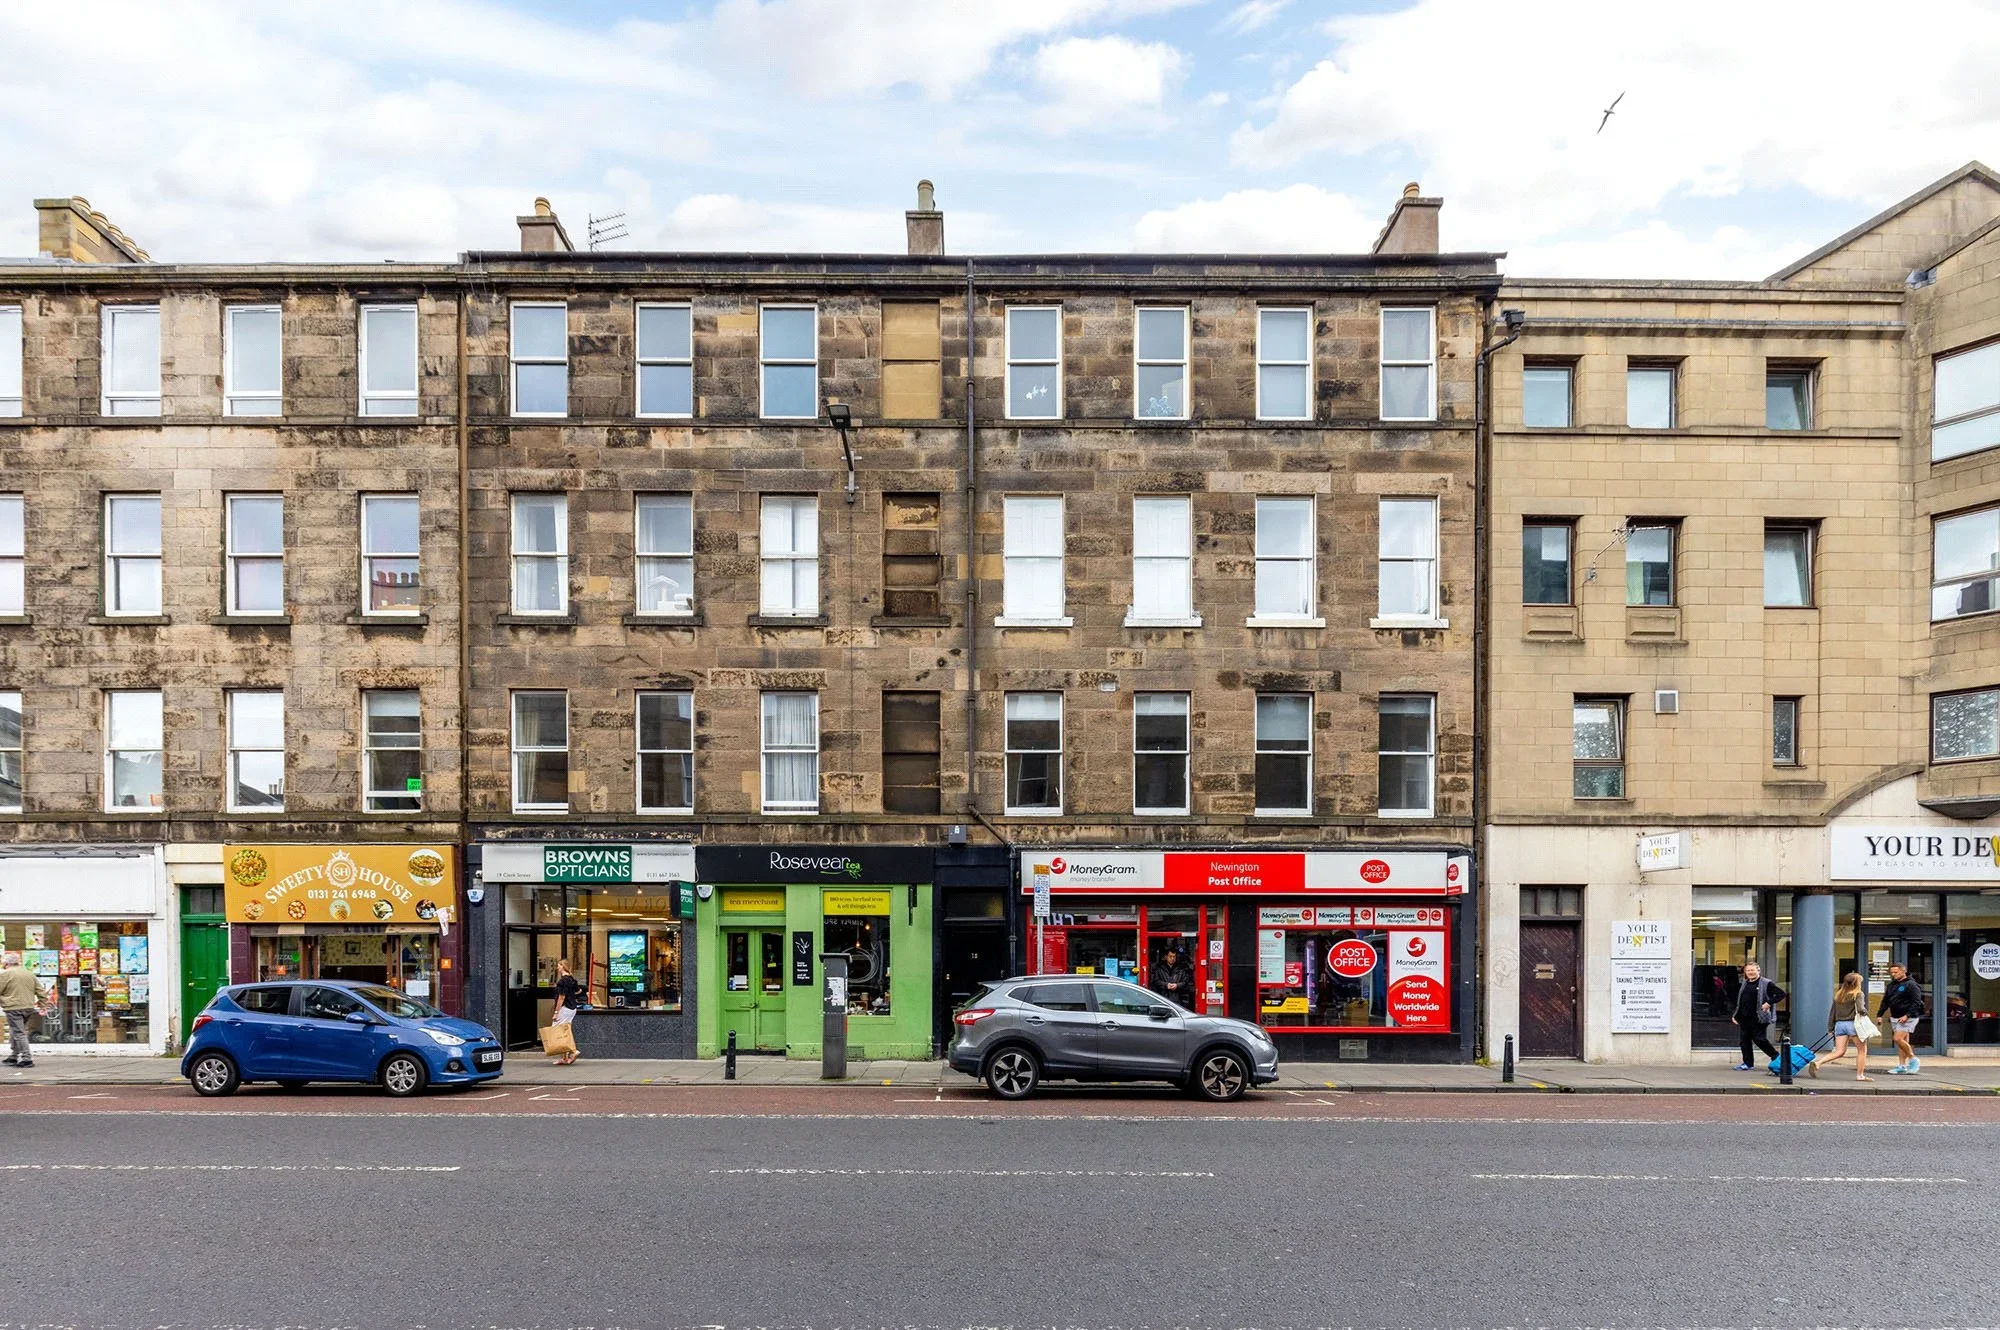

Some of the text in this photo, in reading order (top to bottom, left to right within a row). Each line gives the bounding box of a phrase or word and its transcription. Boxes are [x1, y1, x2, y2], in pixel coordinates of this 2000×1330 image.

[1649, 837, 1670, 846] YOUR
[1864, 836, 1943, 857] YOUR
[545, 850, 630, 864] BROWNS
[770, 851, 850, 870] Rosevear
[545, 864, 630, 878] OPTICIANS
[845, 861, 861, 871] tea
[1069, 864, 1136, 877] MoneyGram
[1210, 861, 1260, 874] Newington
[1366, 864, 1385, 872] POST
[334, 866, 350, 877] SH
[1362, 871, 1388, 879] OFFICE
[264, 864, 413, 905] SWEETY HOUSE
[1208, 876, 1262, 887] Post Office
[307, 889, 376, 899] 0131 241 6948
[1628, 924, 1658, 933] YOUR
[1339, 947, 1367, 957] POST
[1333, 957, 1370, 967] OFFICE
[1395, 959, 1438, 967] MoneyGram
[1405, 980, 1428, 989] Send
[1402, 992, 1431, 1001] Money
[1393, 1002, 1440, 1011] Worldwide
[1406, 1014, 1428, 1022] Here
